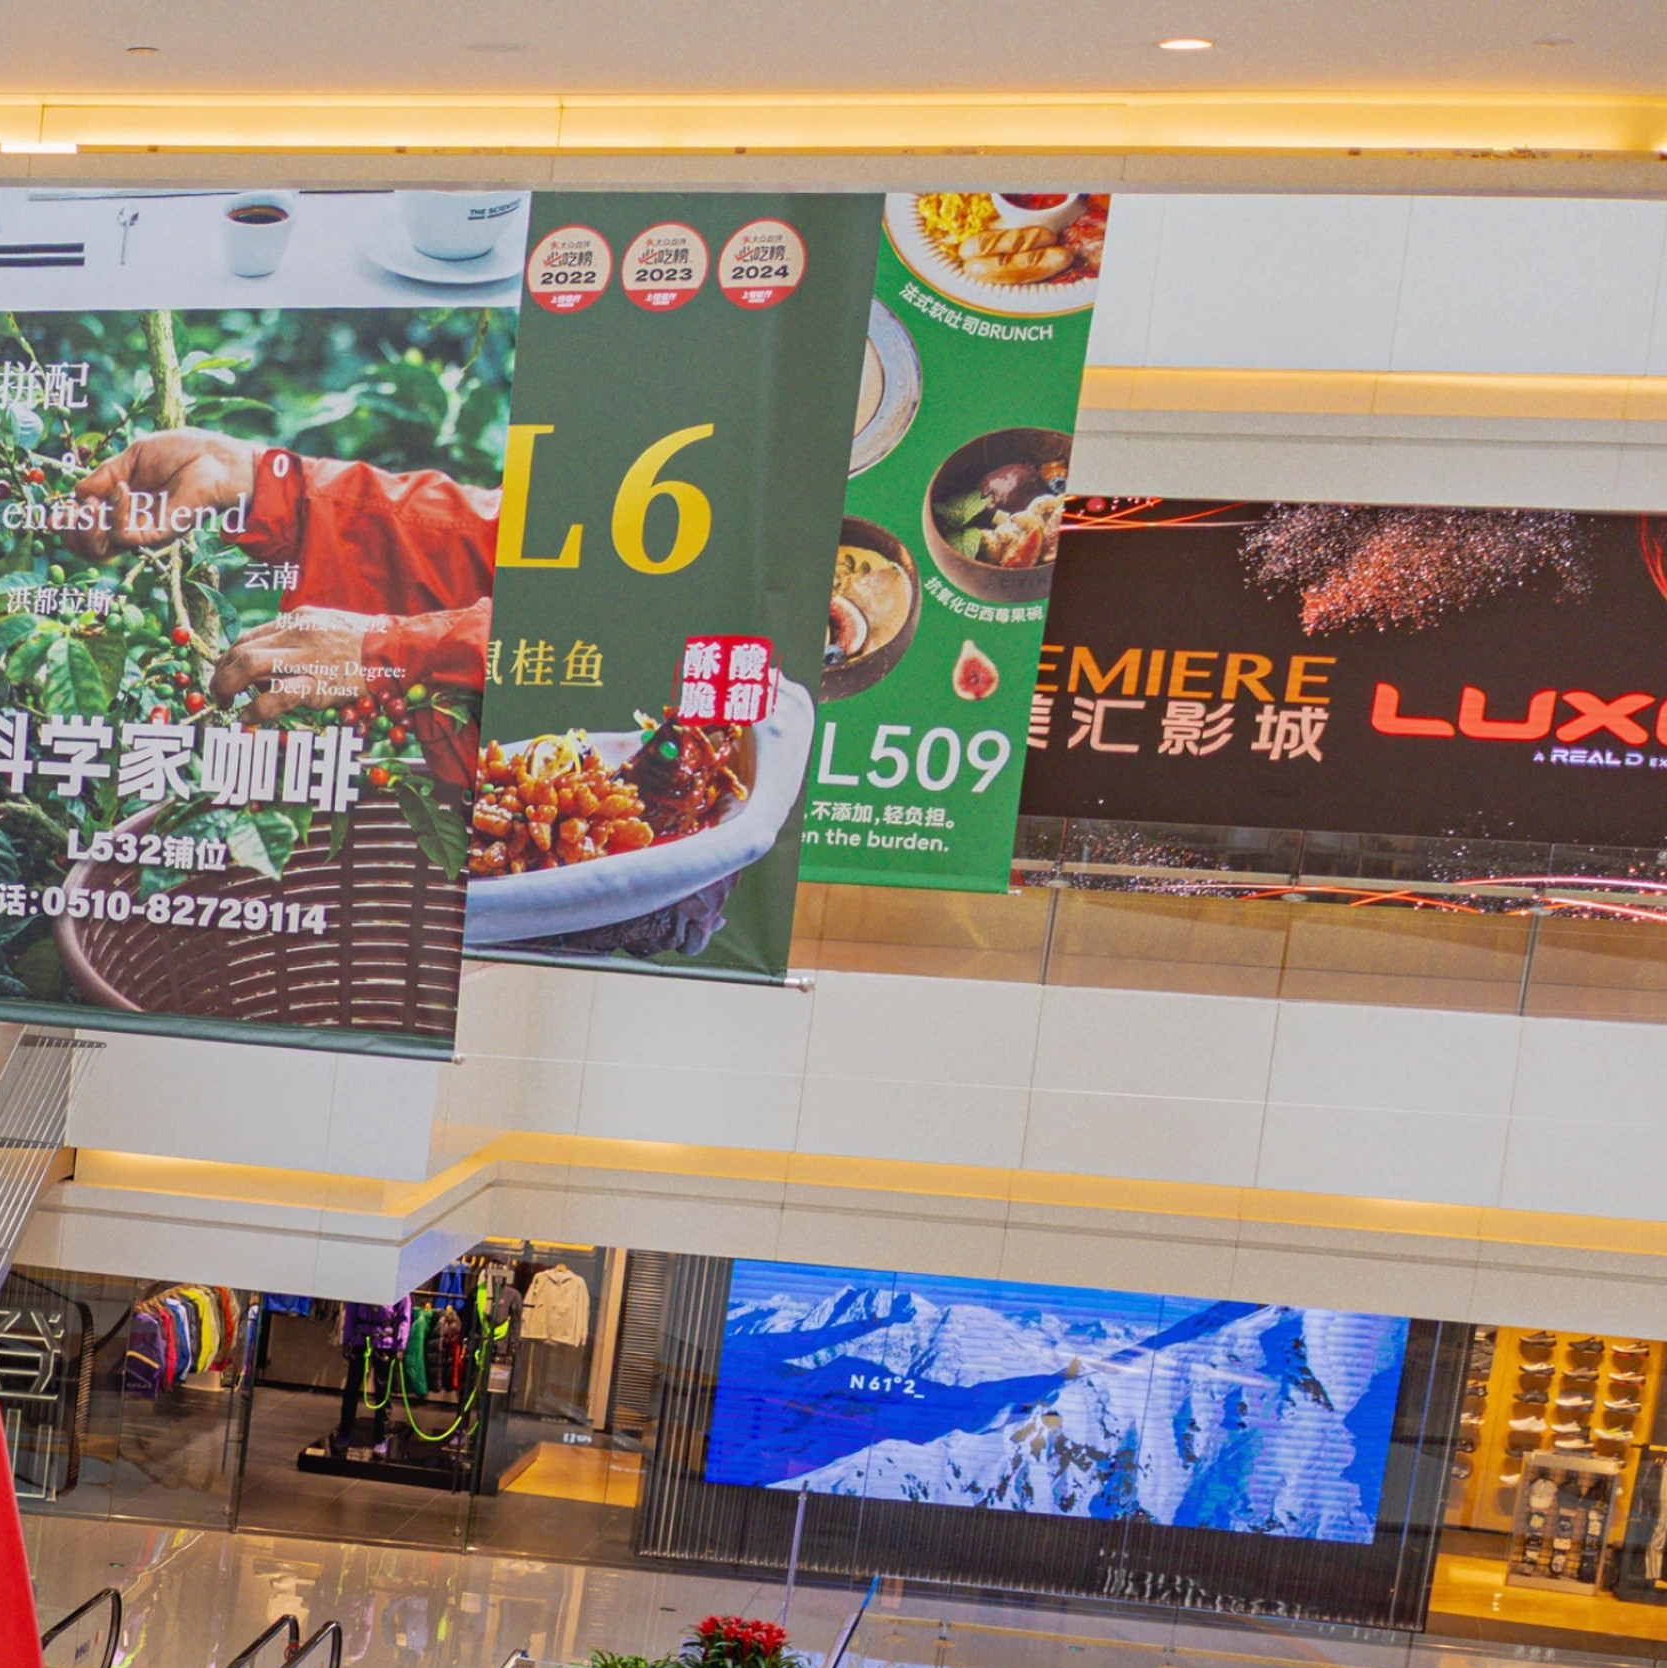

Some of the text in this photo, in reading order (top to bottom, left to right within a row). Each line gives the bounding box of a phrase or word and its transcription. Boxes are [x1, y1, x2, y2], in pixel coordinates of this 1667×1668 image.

[541, 271, 596, 285] 2022
[635, 268, 693, 282] 2023
[732, 265, 789, 279] 2024
[124, 491, 247, 534] Blend
[244, 562, 299, 591] 云南
[7, 588, 111, 616] 洪都拉斯
[271, 658, 406, 682] Roasting Degree:
[269, 678, 359, 698] Deep Roast
[1370, 681, 1667, 746] LUX
[817, 722, 1011, 793] L509
[1533, 752, 1545, 762] A
[67, 828, 227, 871] L532铺位
[825, 828, 861, 847] the
[867, 831, 950, 852] burden.
